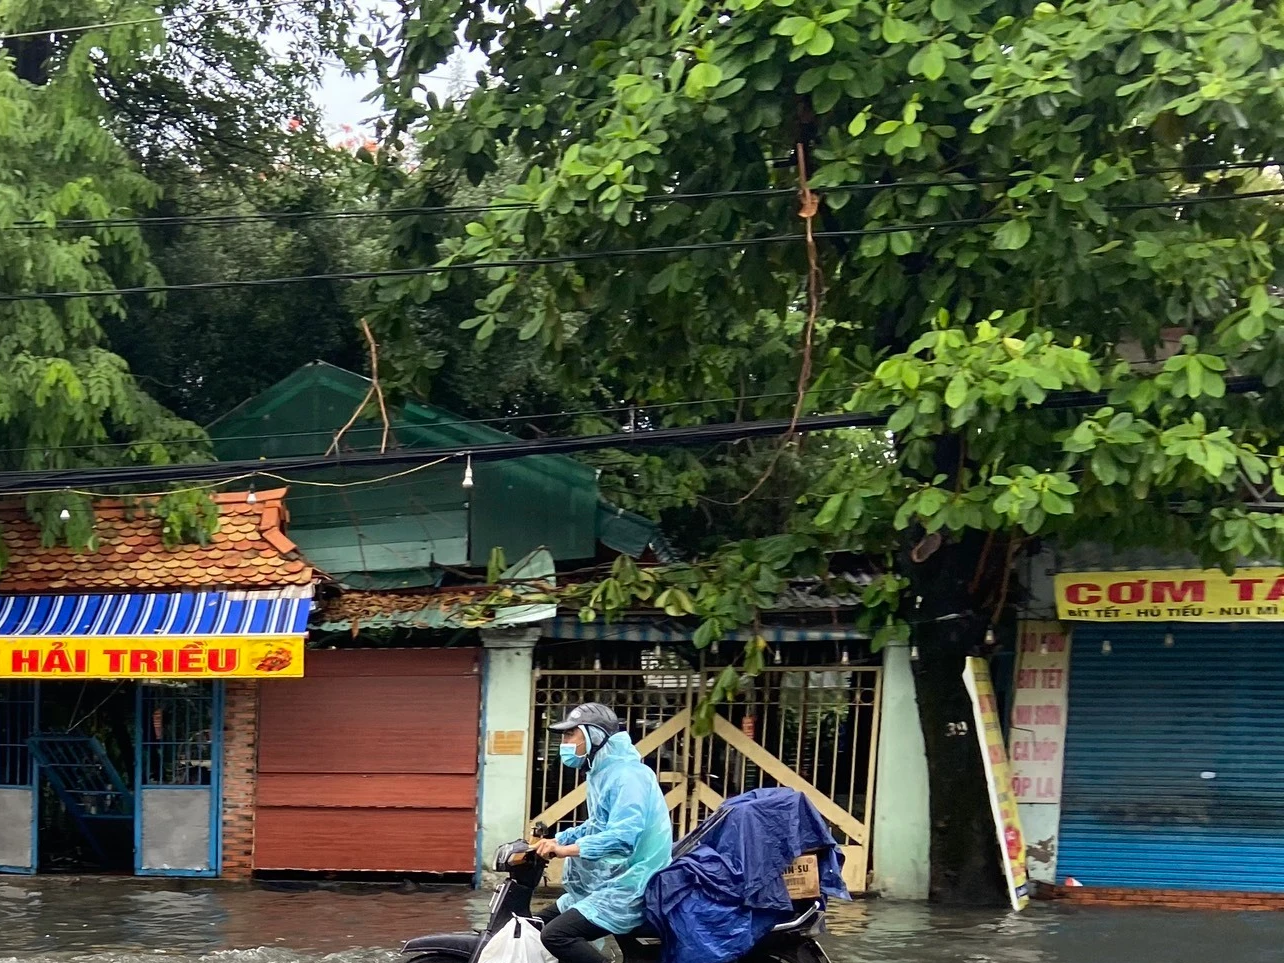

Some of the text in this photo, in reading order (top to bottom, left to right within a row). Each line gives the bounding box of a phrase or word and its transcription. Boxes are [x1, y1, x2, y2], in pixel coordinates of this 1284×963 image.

[1065, 579, 1206, 605] CƠM
[1094, 605, 1120, 618] TẾT
[1137, 605, 1161, 617] HỦ
[1167, 604, 1203, 617] TIẾU
[11, 641, 87, 673] HẢI
[103, 641, 239, 673] TRIỀU
